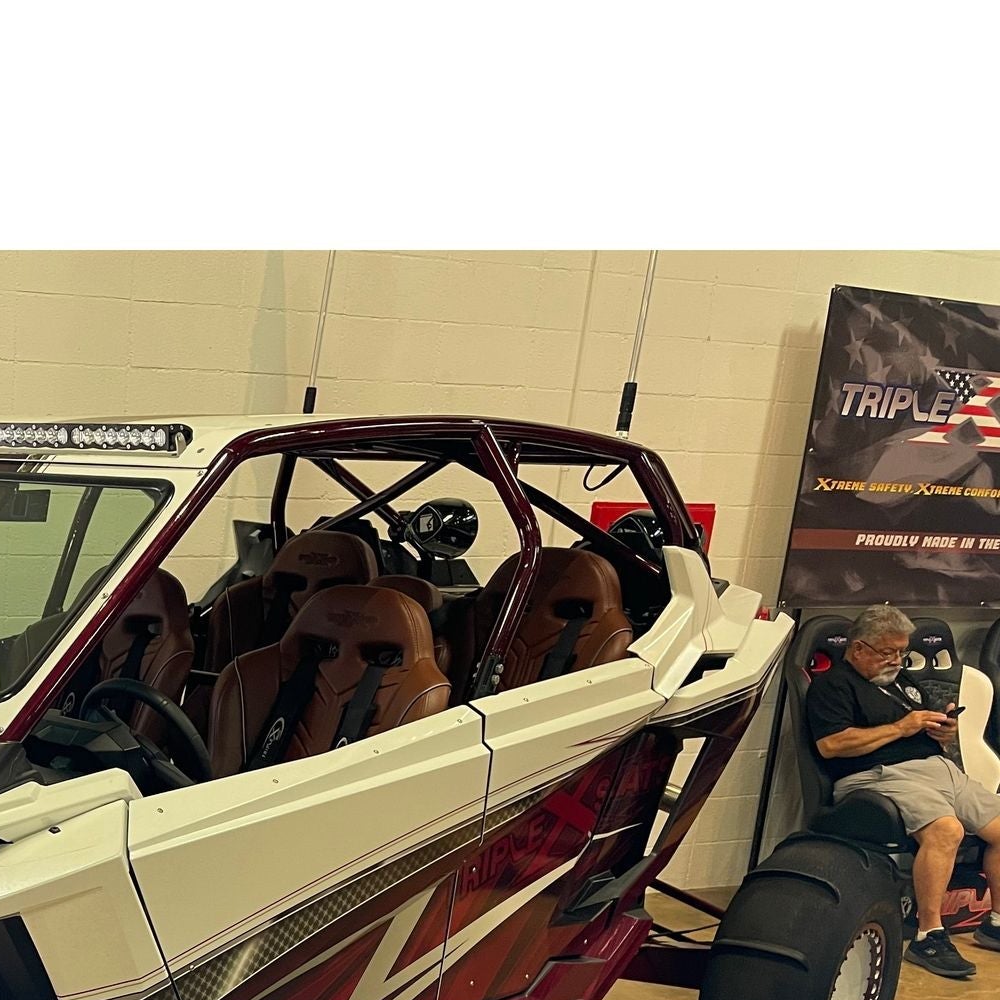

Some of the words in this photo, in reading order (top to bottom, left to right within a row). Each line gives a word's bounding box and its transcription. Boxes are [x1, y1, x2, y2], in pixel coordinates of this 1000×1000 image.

[841, 383, 956, 423] TRIPLE
[814, 477, 867, 491] XTREME
[914, 482, 963, 496] XTREME
[855, 534, 919, 547] PROUDLY
[922, 536, 957, 548] MADE
[960, 537, 975, 549] IN
[978, 538, 1000, 550] THE
